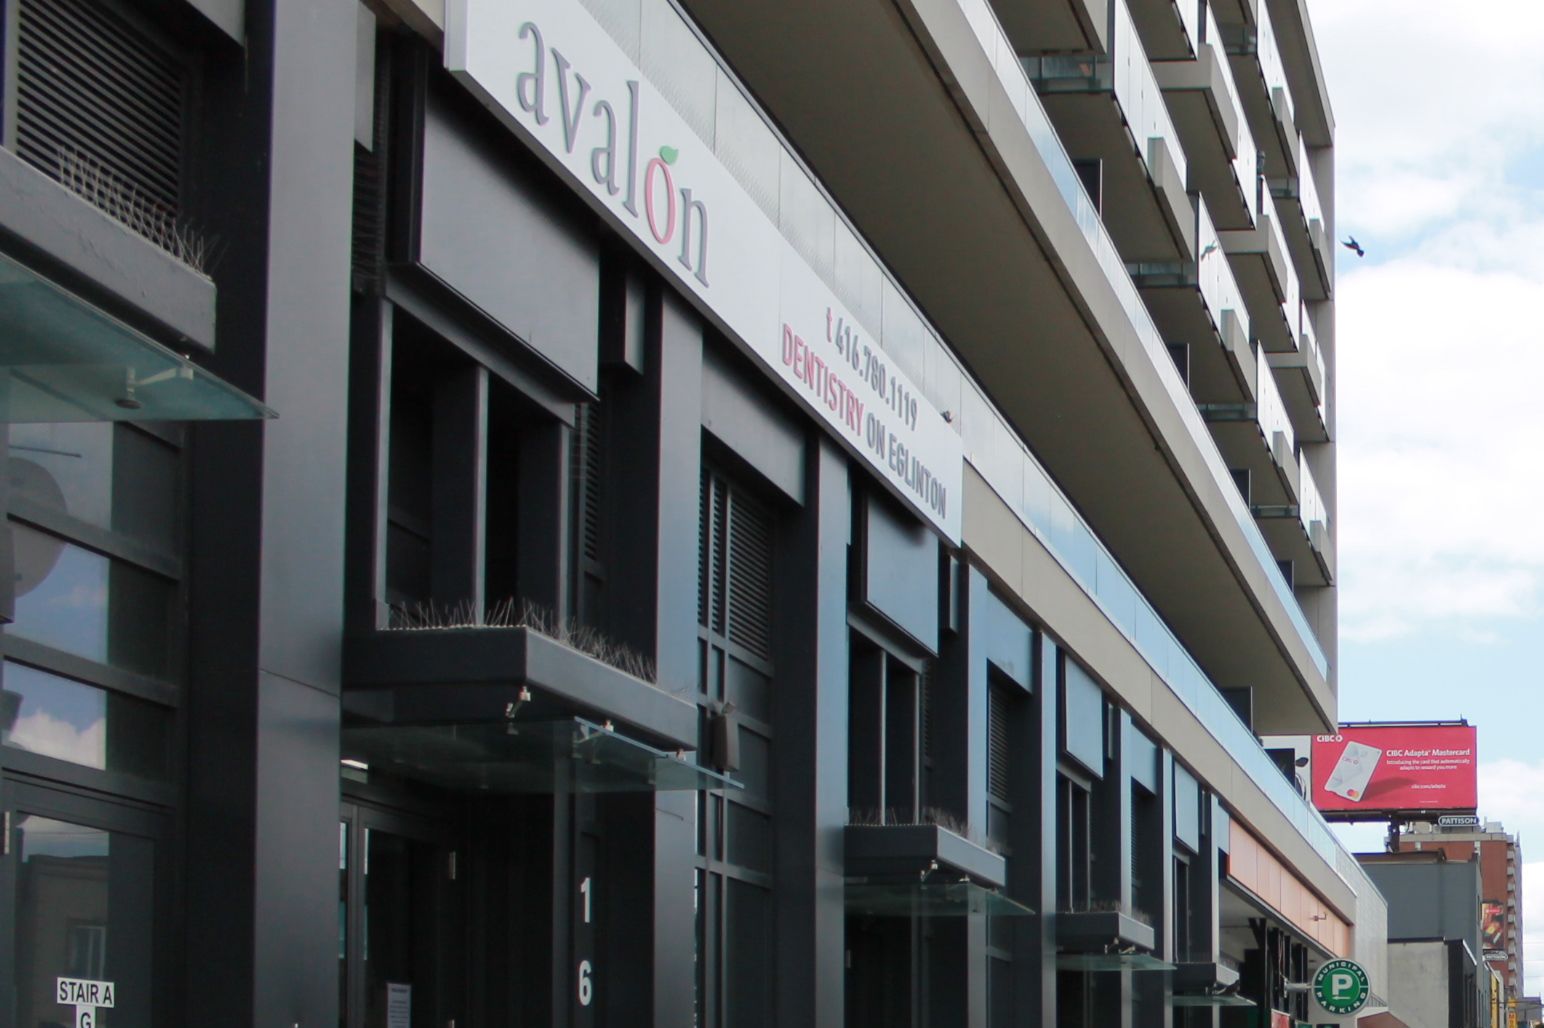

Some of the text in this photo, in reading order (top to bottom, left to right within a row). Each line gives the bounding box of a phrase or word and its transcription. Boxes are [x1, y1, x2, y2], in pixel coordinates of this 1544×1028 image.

[516, 20, 710, 289] avalon
[835, 317, 918, 432] 416.780.1119
[782, 322, 947, 519] DENTISTRY ON EGLINTON
[1316, 735, 1335, 743] CIBC
[1386, 749, 1403, 757] CIBC
[1431, 748, 1470, 757] Mastercard
[1441, 817, 1478, 825] PATTISON
[1318, 961, 1366, 982] MUNICIPAL
[59, 980, 113, 1005] STAIR A
[1331, 973, 1353, 996] P
[1316, 991, 1367, 1014] PARKING
